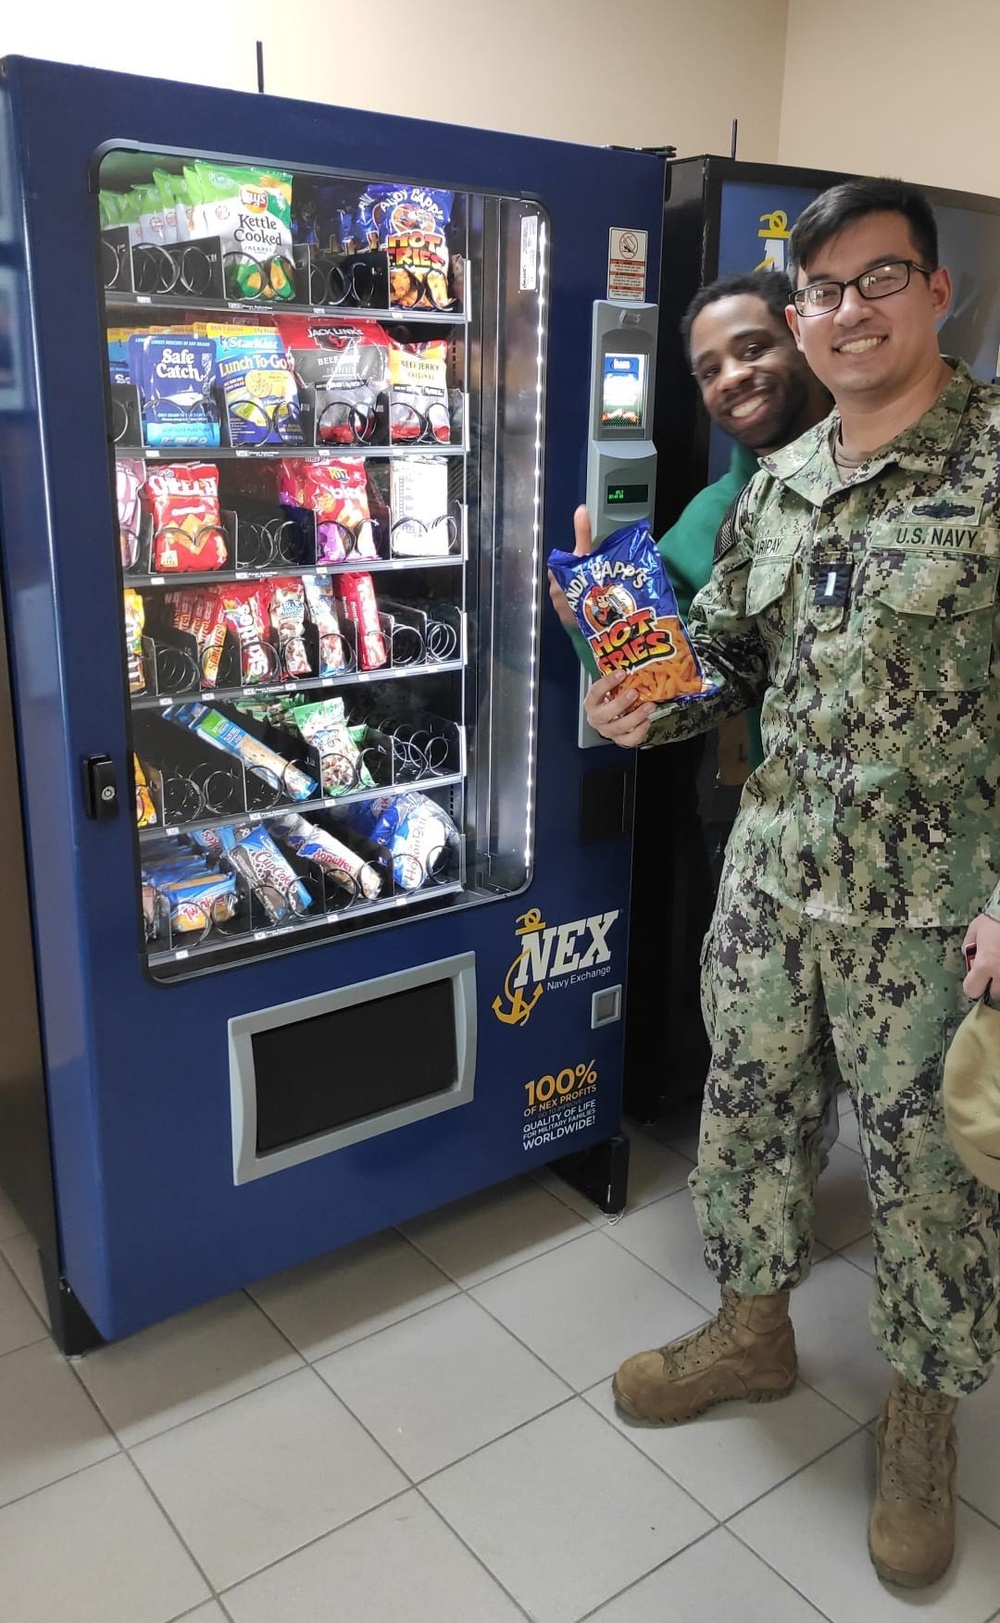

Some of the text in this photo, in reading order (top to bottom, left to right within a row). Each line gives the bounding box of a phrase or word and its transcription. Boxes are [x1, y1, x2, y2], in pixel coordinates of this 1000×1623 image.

[238, 213, 277, 231] Kettle
[233, 228, 282, 246] Cooked
[307, 328, 333, 338] JACK
[161, 348, 195, 365] Safe
[219, 356, 253, 378] Lunch
[253, 354, 287, 370] To-Go
[401, 360, 440, 371] BEEF JERKY
[156, 363, 206, 382] Catch
[896, 527, 978, 549] U.S. NAVY
[566, 565, 591, 612] ANDY
[590, 611, 654, 655] HOT
[599, 631, 672, 676] FRIES
[513, 909, 619, 988] NEX
[547, 965, 611, 991] Navy Exchange
[524, 1059, 597, 1106] 100%
[523, 1084, 597, 1117] OF NEX PROFITS
[522, 1107, 596, 1141] FOR MILITARY FAMILIES
[523, 1099, 596, 1134] QUALITY OF LIFE
[522, 1114, 597, 1151] WORLDWIDE!
